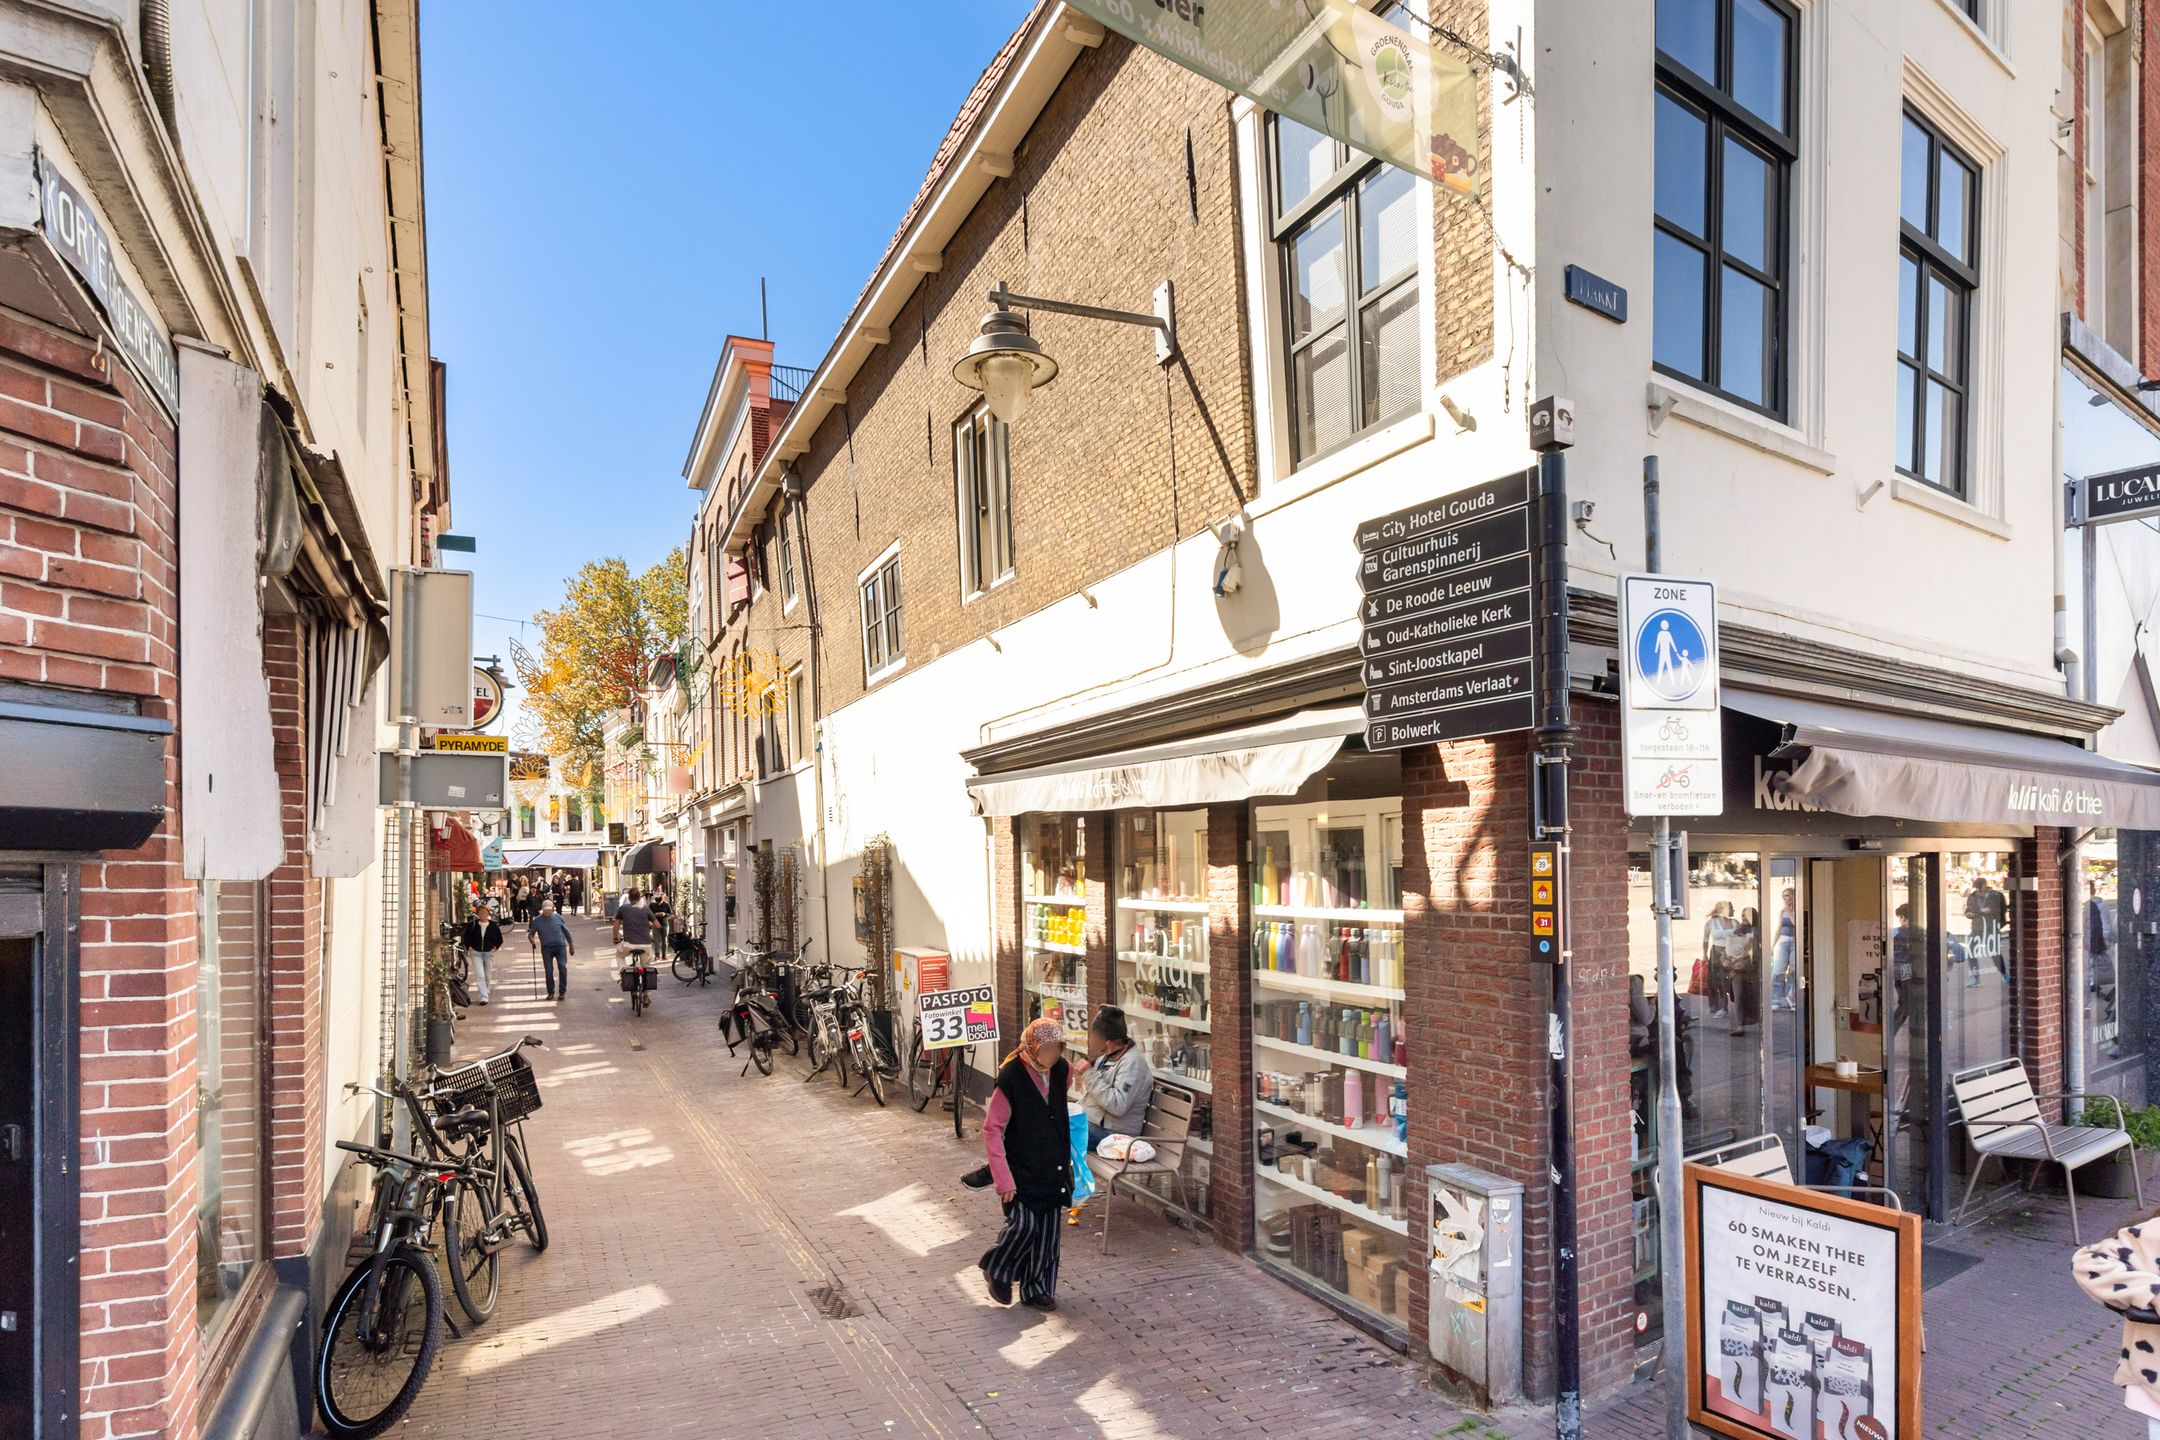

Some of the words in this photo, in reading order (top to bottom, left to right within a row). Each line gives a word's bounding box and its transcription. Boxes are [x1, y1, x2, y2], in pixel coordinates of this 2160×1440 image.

[1381, 93, 1405, 110] GOUDA
[46, 171, 108, 295] KORTE
[2097, 474, 2160, 502] LUCA
[1382, 520, 1406, 538] City
[1410, 504, 1446, 530] Hotel
[1449, 491, 1495, 516] Gouda
[1382, 532, 1459, 564] Cultuurhuis
[1383, 542, 1481, 582] Garenspinnerij
[1386, 599, 1403, 613] De
[1405, 587, 1445, 608] Roode
[1449, 576, 1492, 598] Leeuw
[1654, 587, 1687, 601] ZONE
[1386, 614, 1478, 645] Oud-Katholieke
[1481, 604, 1512, 624] Kerk
[1388, 643, 1483, 676] Sint-Joostkapel
[1391, 684, 1464, 708] Amsterdams
[1466, 674, 1512, 695] Verlaat
[1391, 720, 1441, 741] Bolwerk
[439, 740, 505, 752] PYRAMYDE
[1640, 743, 1683, 753] toegestaan
[1120, 777, 1131, 796] &
[2062, 790, 2074, 813] &
[1540, 918, 1548, 926] 31
[1965, 916, 2001, 960] kaldi
[1135, 930, 1193, 989] kaldi
[922, 989, 991, 1009] PASFOTO
[925, 1008, 962, 1020] Fotowinkel
[929, 1015, 963, 1042] 33
[967, 1021, 988, 1034] meij
[968, 1029, 997, 1041] boom
[1759, 1206, 1789, 1221] Nieuw
[1791, 1214, 1804, 1227] bij
[1806, 1217, 1831, 1232] Kaldi
[1728, 1220, 1747, 1234] 60
[1751, 1226, 1820, 1254] SMAKEN
[1825, 1245, 1865, 1266] THEE
[1753, 1244, 1780, 1261] OM
[1784, 1253, 1837, 1277] JEZELF
[1735, 1256, 1751, 1270] TE
[1755, 1262, 1856, 1302] VERRASSEN.
[1731, 1304, 1749, 1315] kaldi
[1759, 1299, 1777, 1310] kaldi
[1810, 1316, 1829, 1328] kaldi
[1783, 1331, 1801, 1342] kaldi
[1837, 1342, 1858, 1353] kaldi
